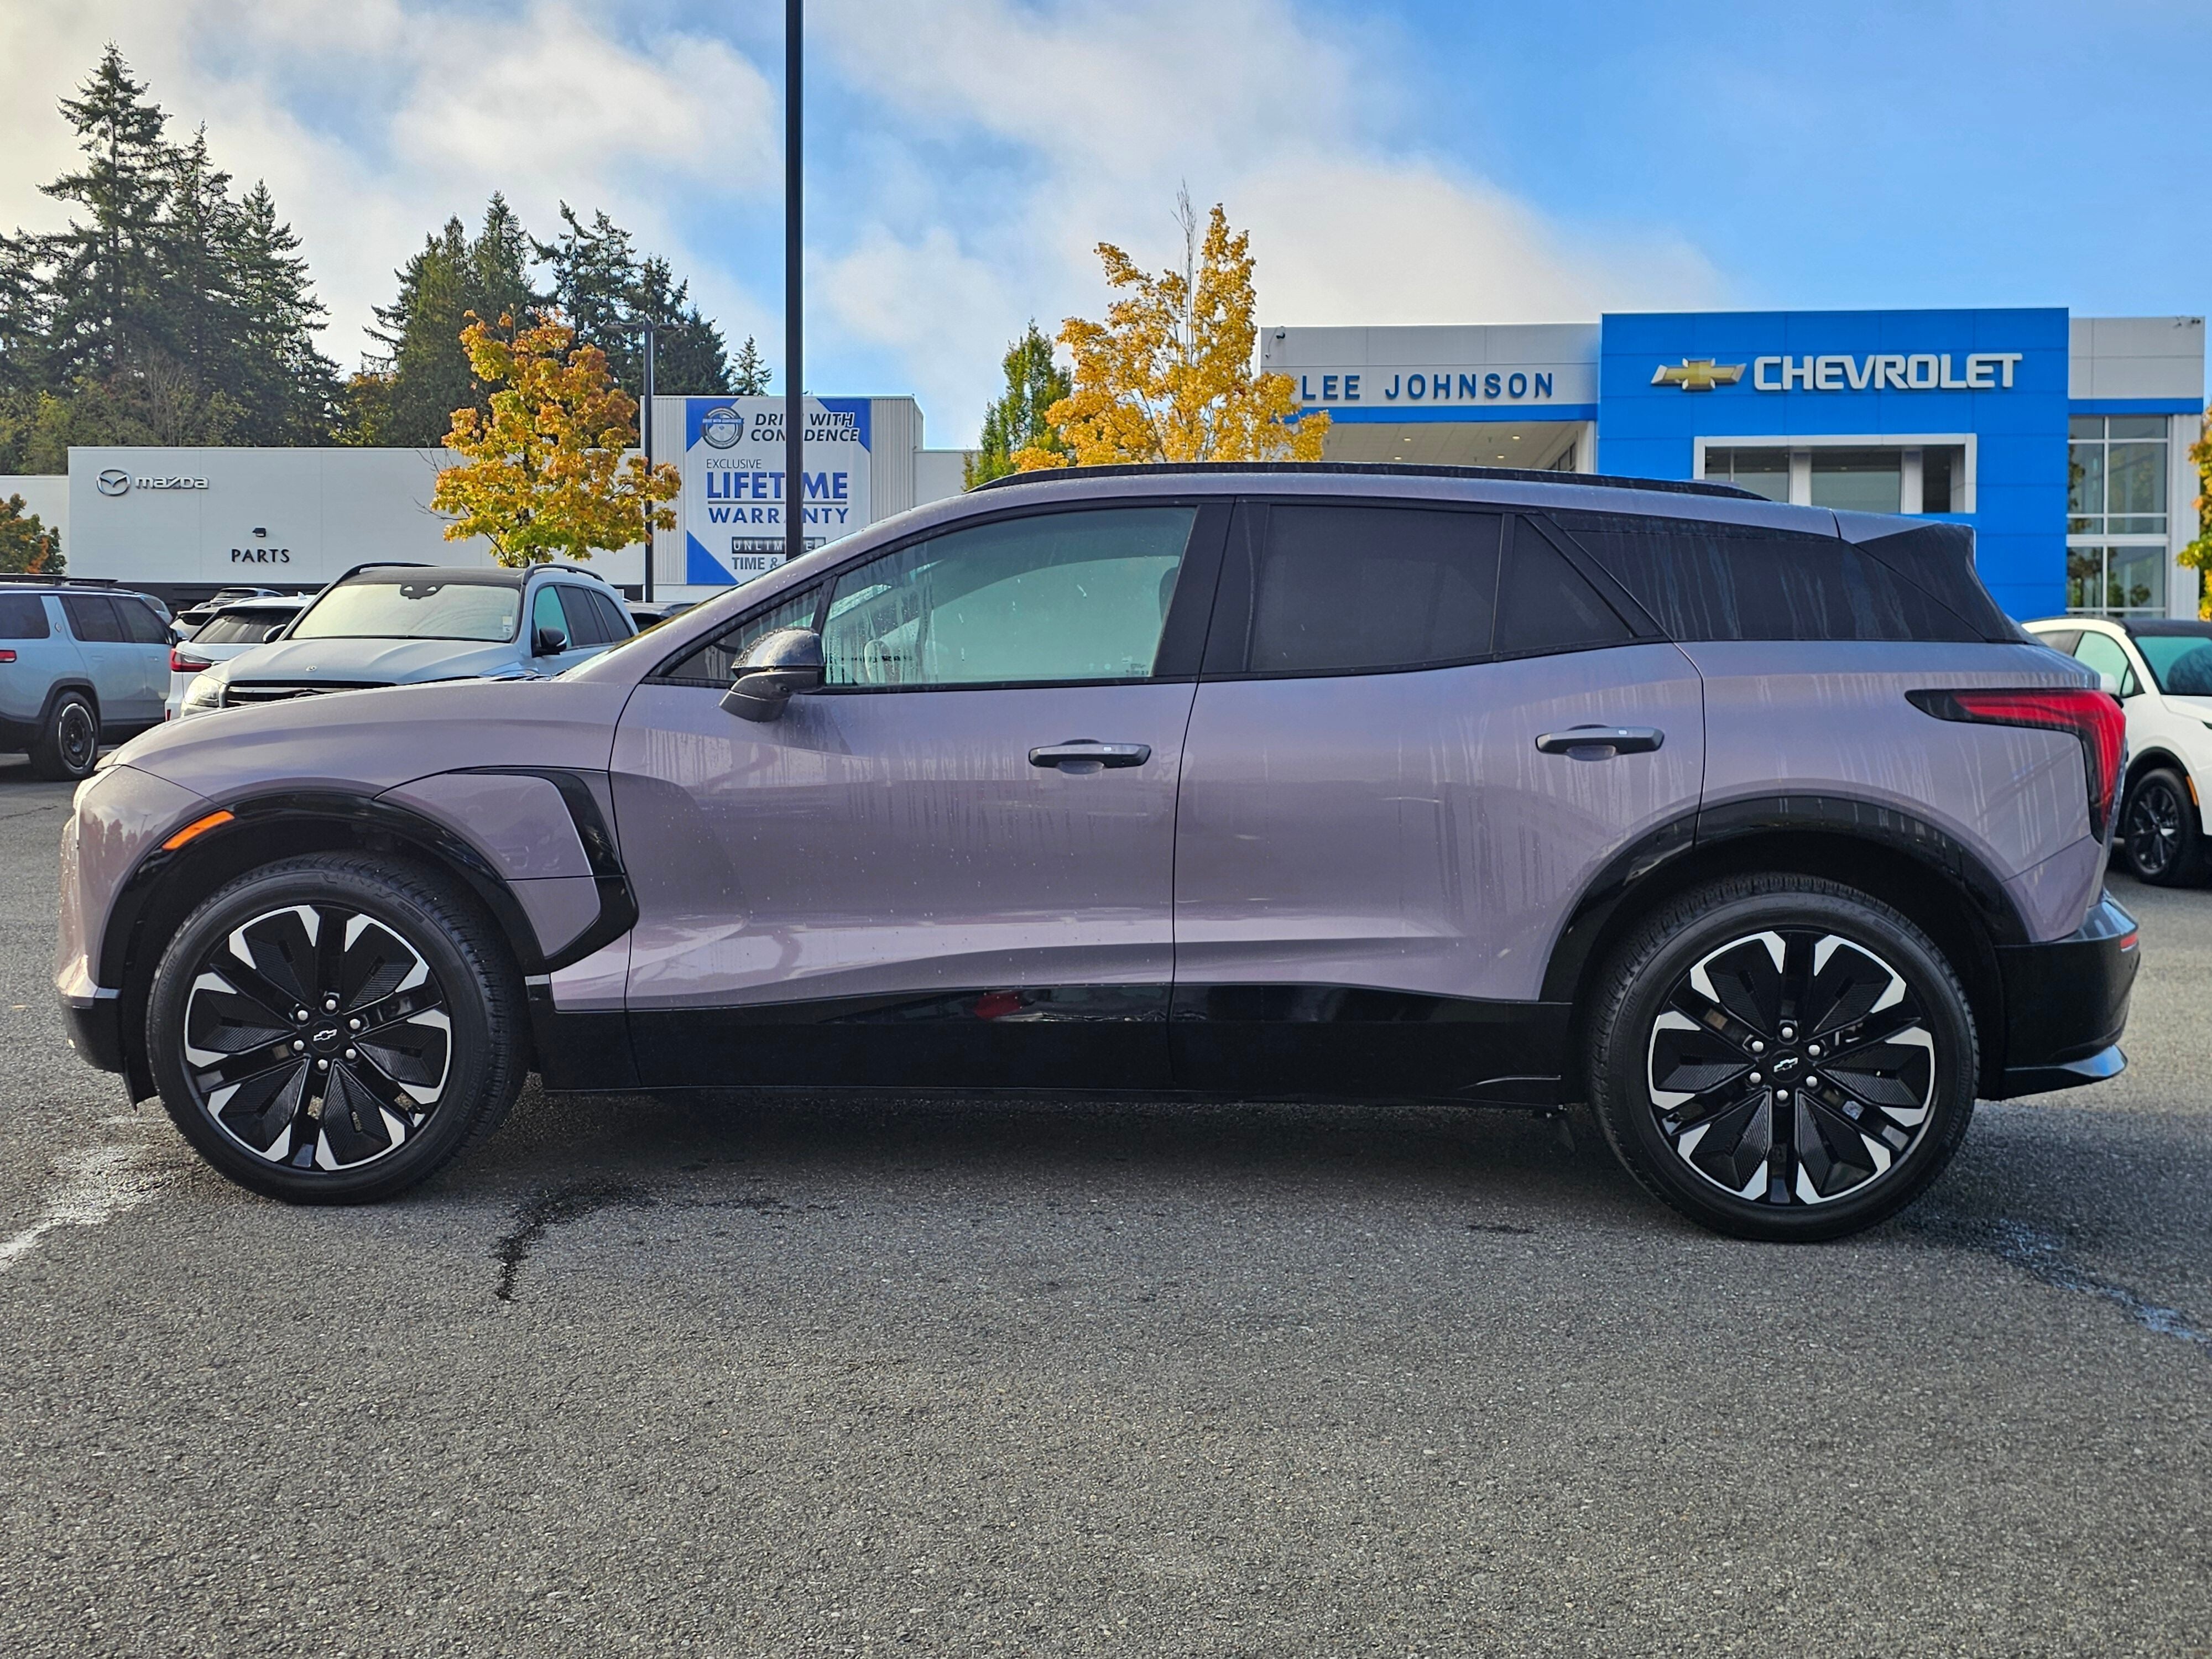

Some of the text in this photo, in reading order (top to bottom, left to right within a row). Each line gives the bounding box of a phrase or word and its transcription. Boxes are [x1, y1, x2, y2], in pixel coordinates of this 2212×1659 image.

[1754, 353, 2023, 390] CHEVROLET
[1302, 372, 1553, 401] LEE JOHNSON
[755, 413, 804, 426] DRI
[810, 413, 854, 426] WITH
[750, 429, 859, 441] CONDENCE
[706, 458, 762, 469] EXCLUSIVE
[134, 476, 209, 489] mazda
[707, 472, 848, 499] LIFETME
[708, 508, 849, 524] WARRNTY
[733, 539, 822, 551] UNLIME
[231, 549, 290, 563] PARTS
[732, 557, 780, 570] TIME &
